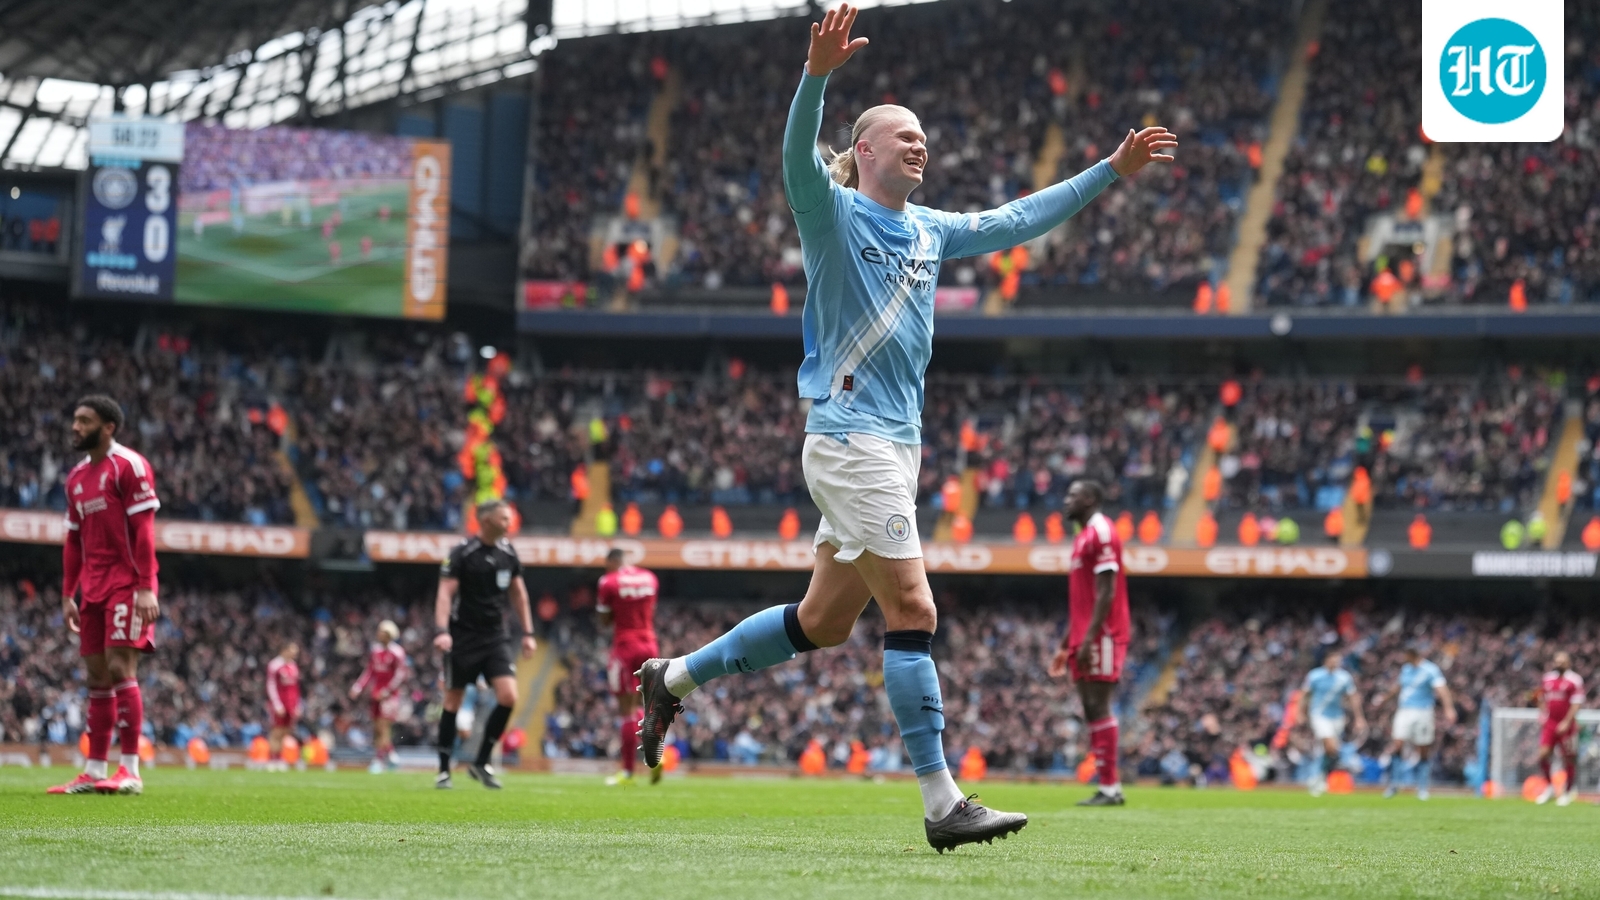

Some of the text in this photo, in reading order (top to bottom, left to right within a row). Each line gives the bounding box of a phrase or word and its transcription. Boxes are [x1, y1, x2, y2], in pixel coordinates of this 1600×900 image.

[146, 165, 171, 214] 3
[143, 214, 169, 263] 0
[410, 155, 441, 303] ETIHAD
[884, 272, 931, 292] AIRWAYS
[161, 525, 295, 555] ETIHAD
[680, 541, 815, 568] ETIHAD
[1205, 547, 1348, 575] ETIHAD
[113, 604, 128, 628] 2
